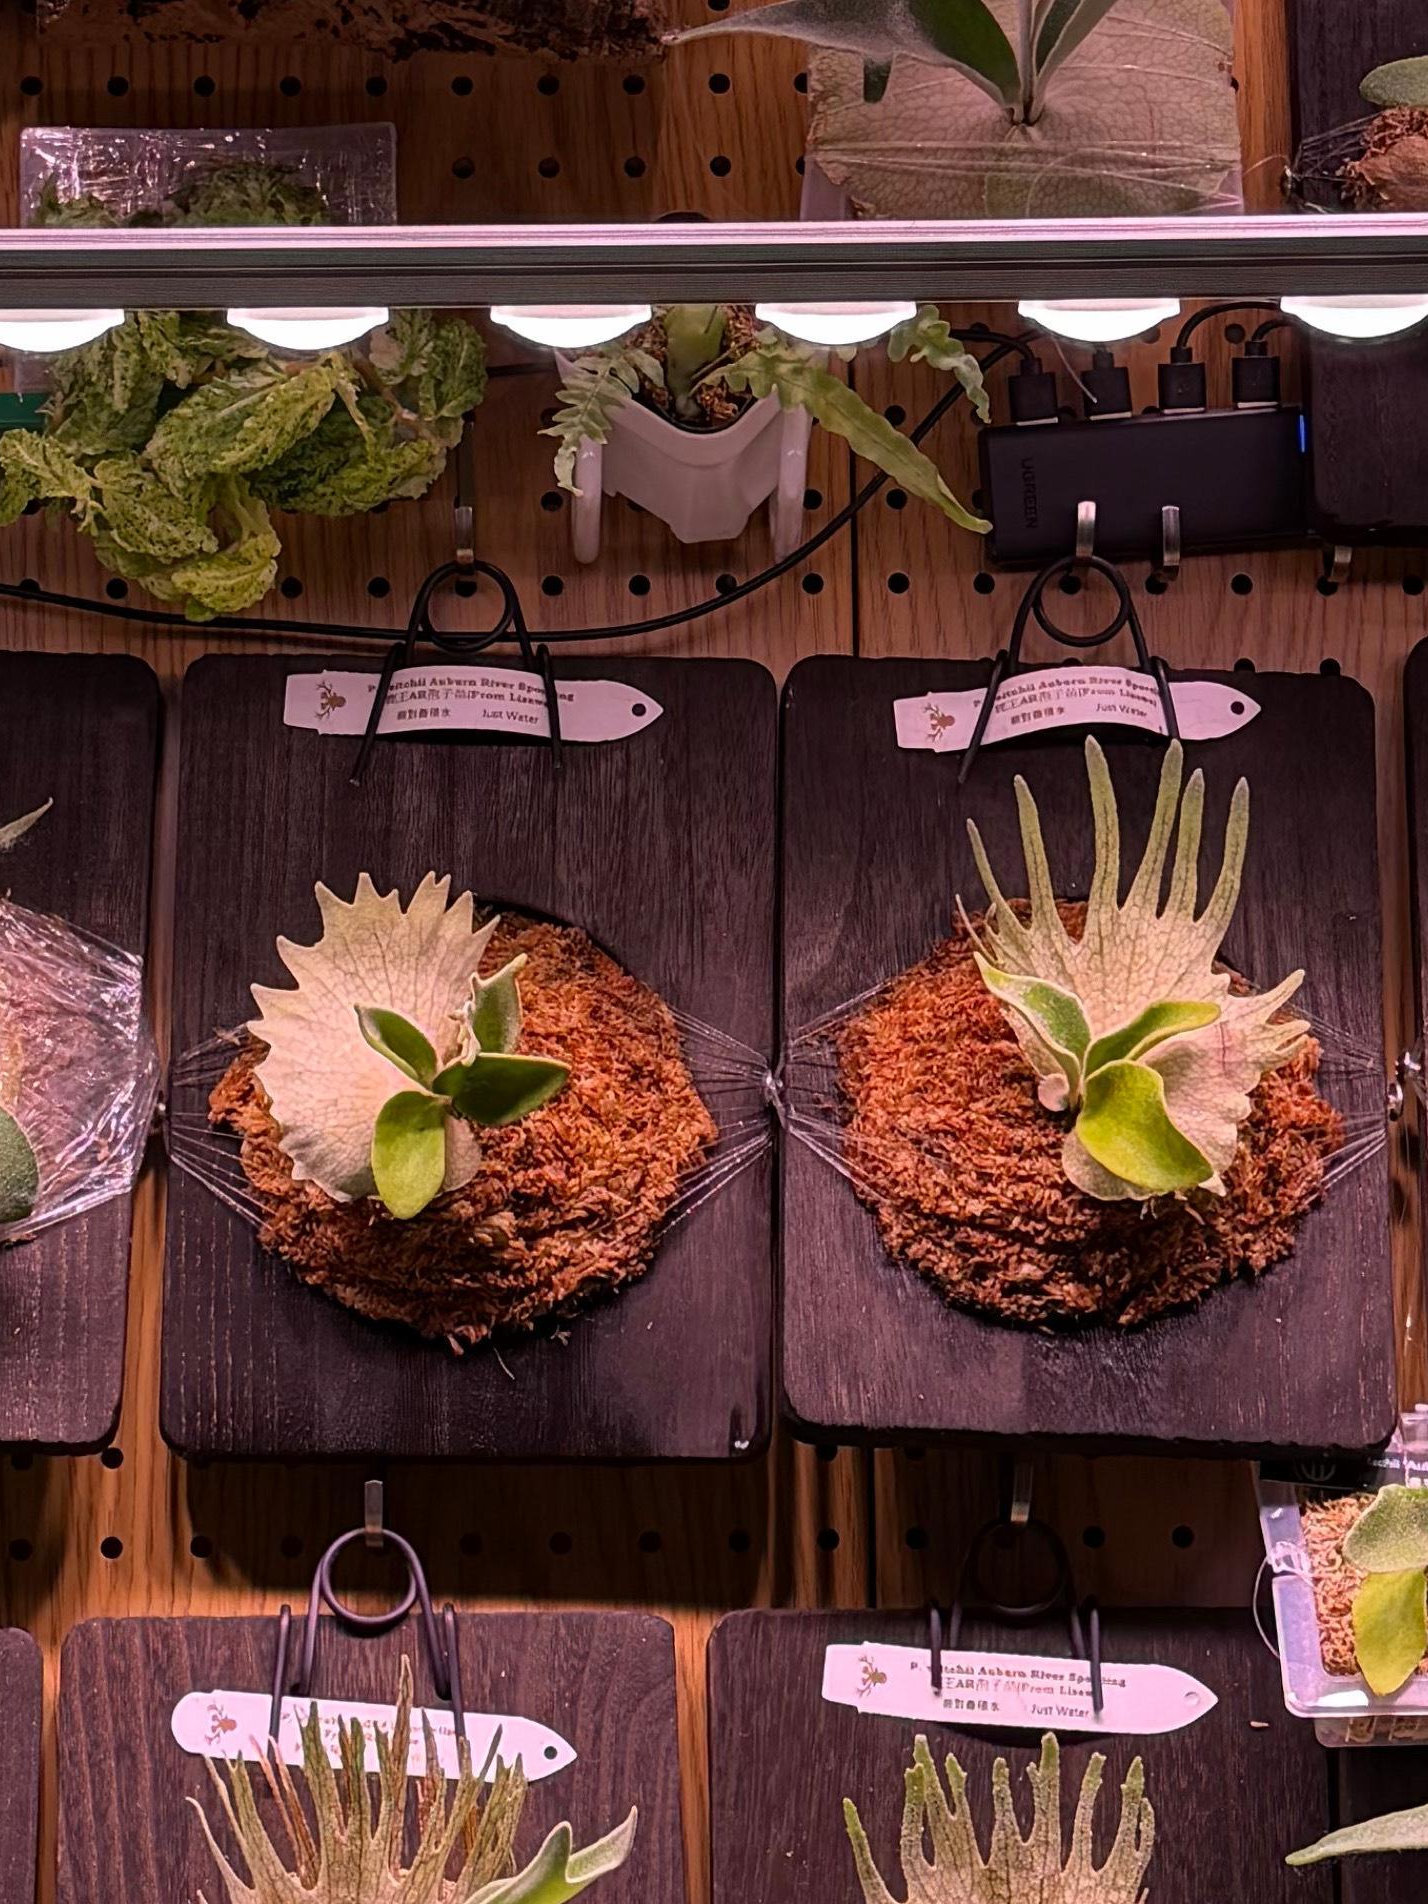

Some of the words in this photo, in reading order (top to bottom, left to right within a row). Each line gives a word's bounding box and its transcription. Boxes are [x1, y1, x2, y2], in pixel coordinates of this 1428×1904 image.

[1021, 456, 1038, 529] UGREEN
[389, 679, 427, 693] eitchii
[429, 678, 477, 688] Auburn
[480, 678, 514, 690] River
[505, 710, 539, 724] Water
[1056, 1706, 1090, 1721] Water
